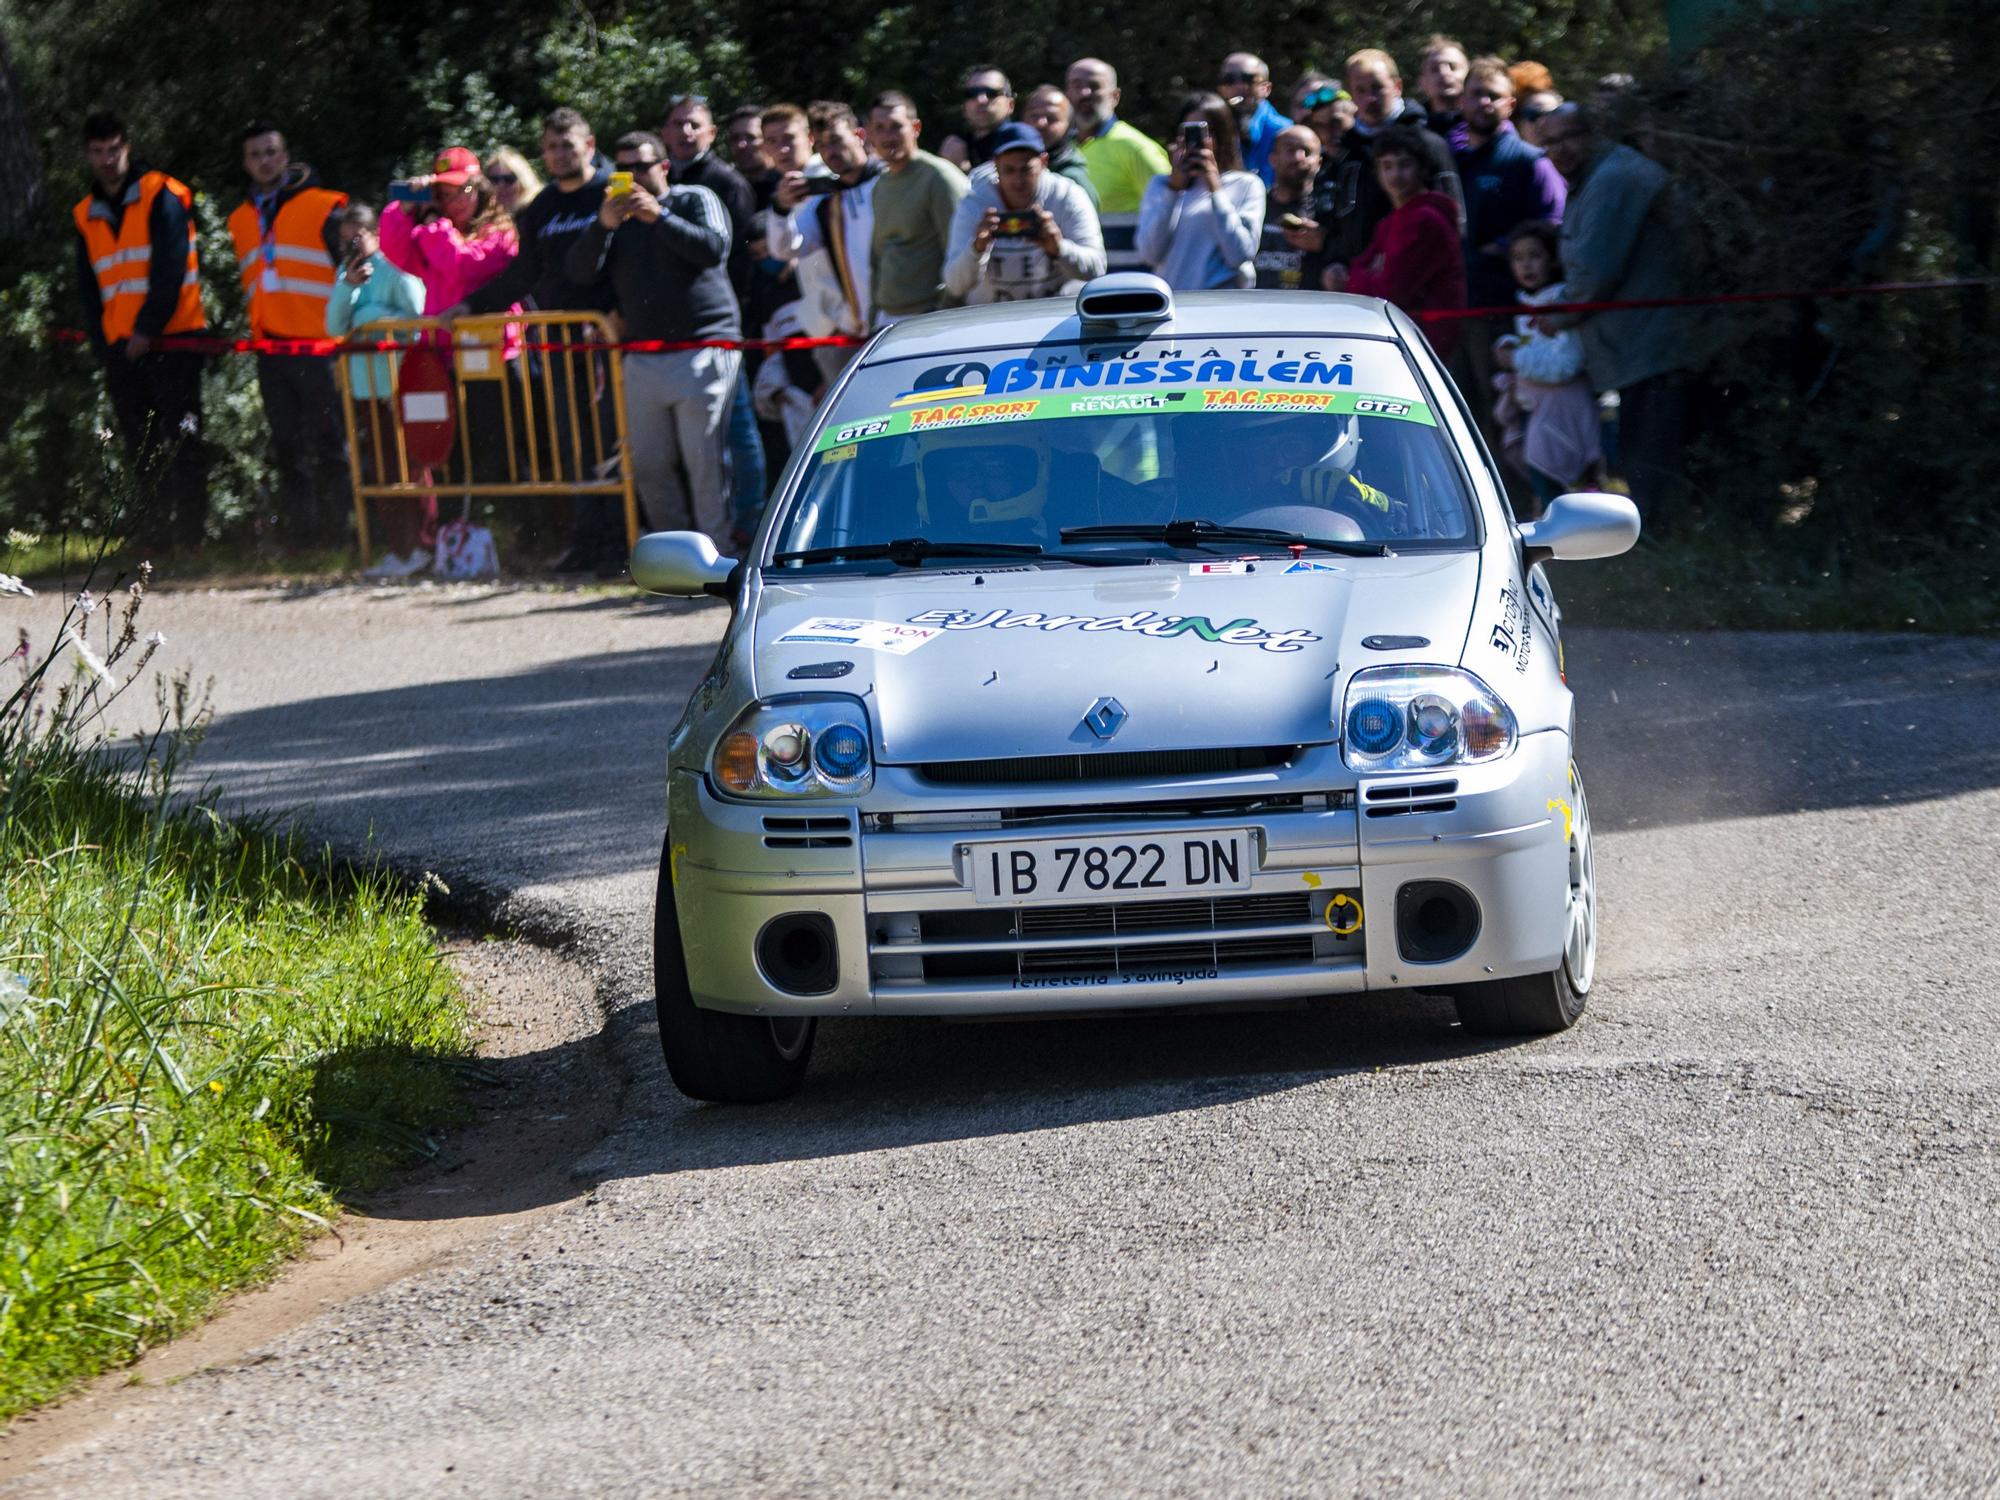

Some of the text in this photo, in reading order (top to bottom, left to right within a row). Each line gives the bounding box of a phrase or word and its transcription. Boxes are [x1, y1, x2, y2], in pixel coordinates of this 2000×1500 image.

[1046, 347, 1353, 365] NEUMÀTICS
[984, 358, 1353, 395] BINISSALEM
[1071, 398, 1169, 412] RENAULT
[1203, 390, 1334, 406] TAC SPORT
[1204, 403, 1325, 411] Racing Parts
[910, 412, 1030, 431] Racing Parts
[911, 406, 966, 425] TAC
[967, 401, 1039, 418] SPORT
[1054, 843, 1166, 893] 7822
[1183, 838, 1239, 885] DN
